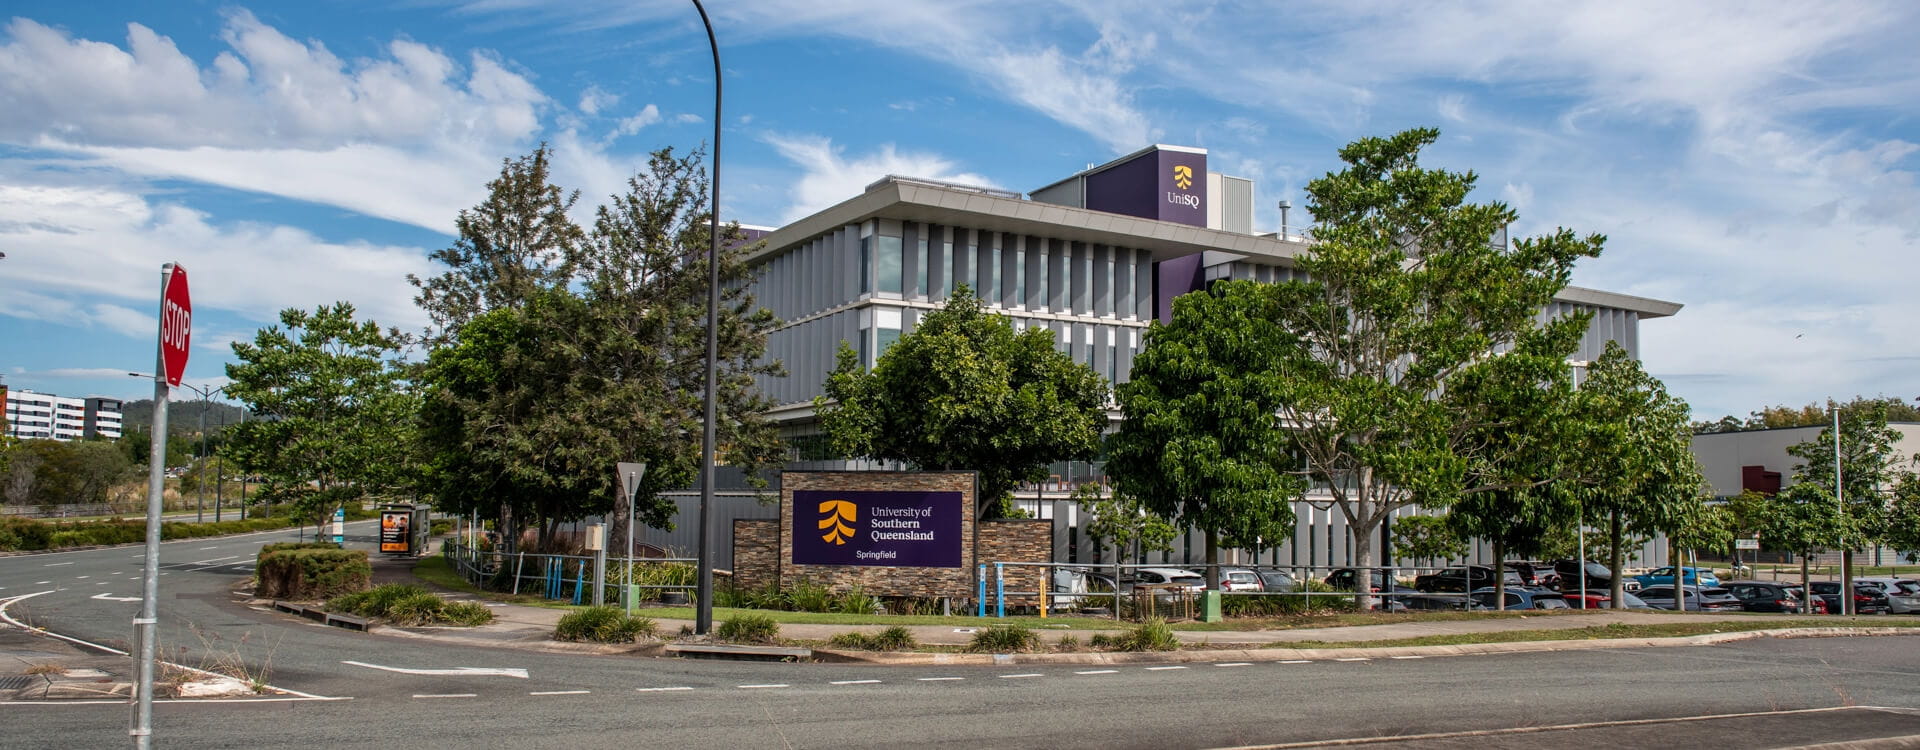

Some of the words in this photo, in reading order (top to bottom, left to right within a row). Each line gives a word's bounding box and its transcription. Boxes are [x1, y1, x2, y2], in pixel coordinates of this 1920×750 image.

[1167, 191, 1200, 210] UniSQ
[164, 298, 190, 352] STOP
[871, 506, 920, 519] University
[921, 506, 933, 517] of
[871, 518, 920, 528] Southern
[871, 530, 934, 542] Queensland
[856, 550, 897, 560] Springfield
